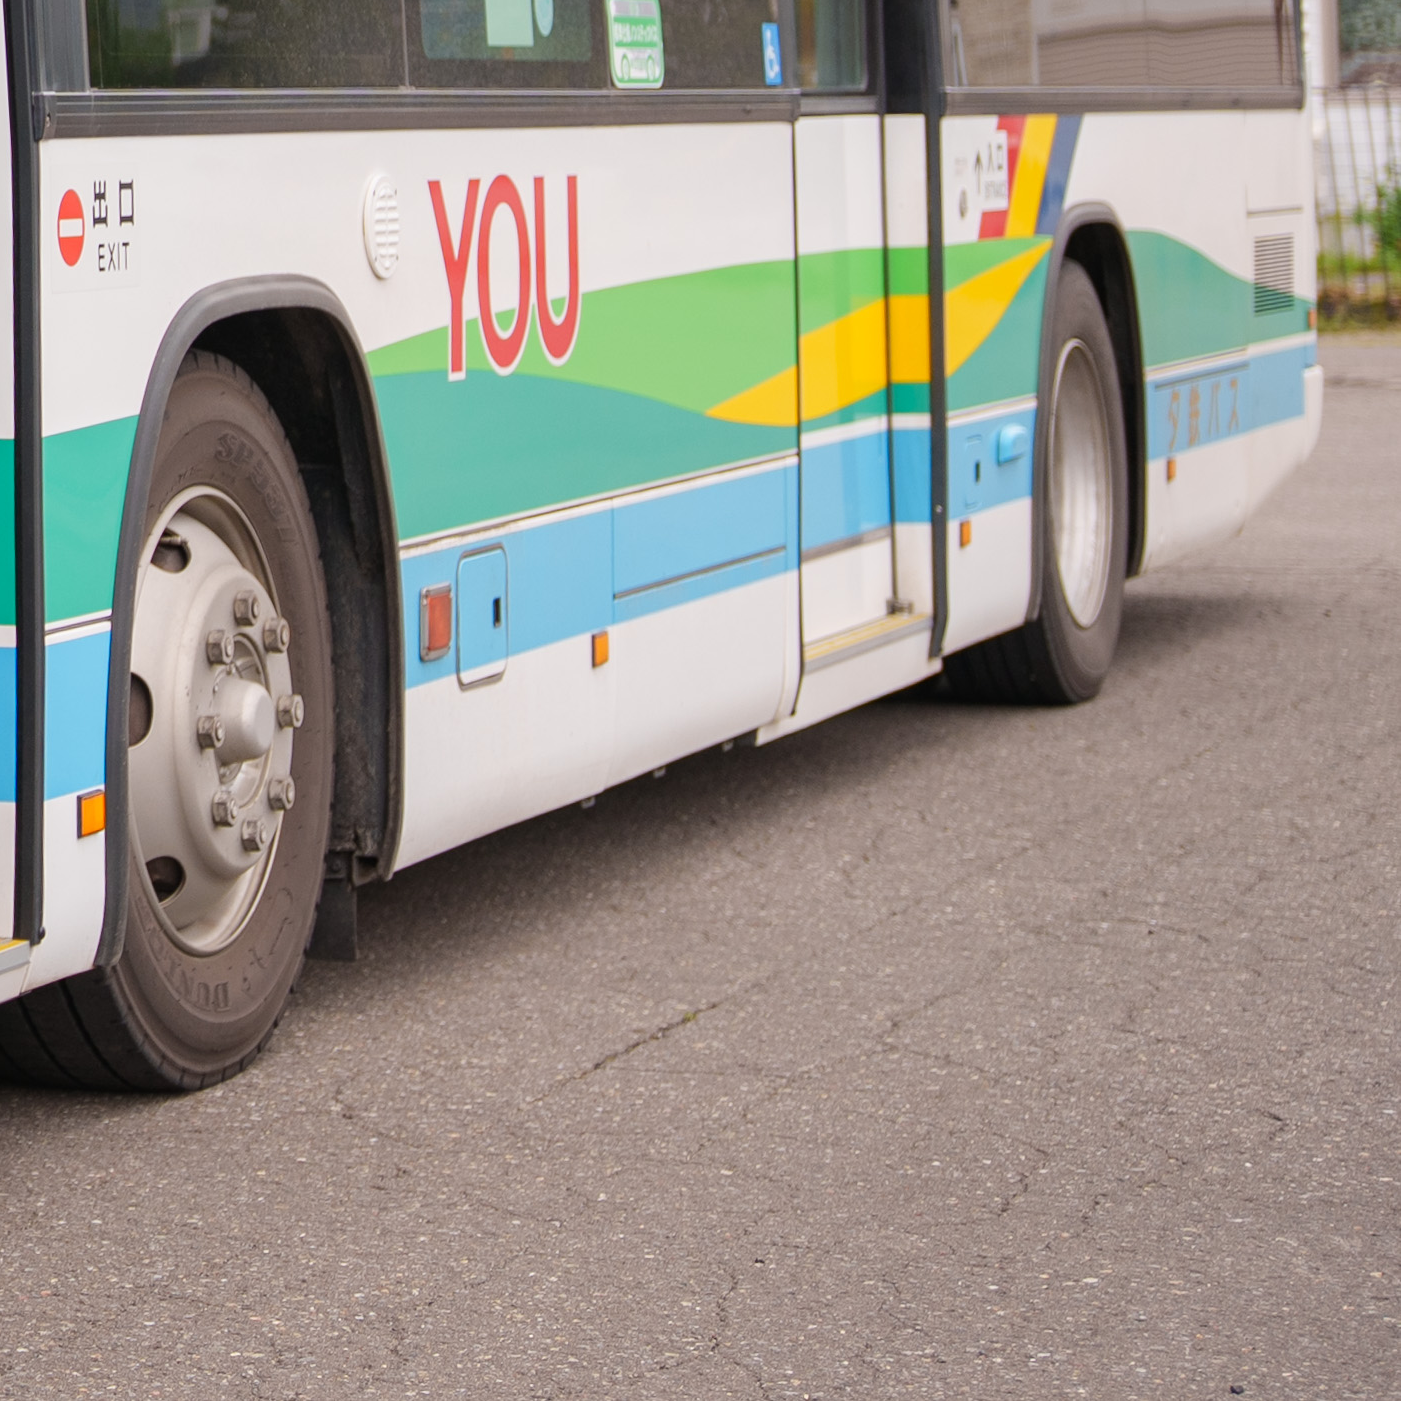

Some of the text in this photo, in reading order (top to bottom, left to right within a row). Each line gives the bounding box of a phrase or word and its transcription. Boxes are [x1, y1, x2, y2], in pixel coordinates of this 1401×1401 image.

[92, 180, 134, 228] 出口
[98, 242, 130, 271] EXIT
[427, 174, 579, 376] YOU
